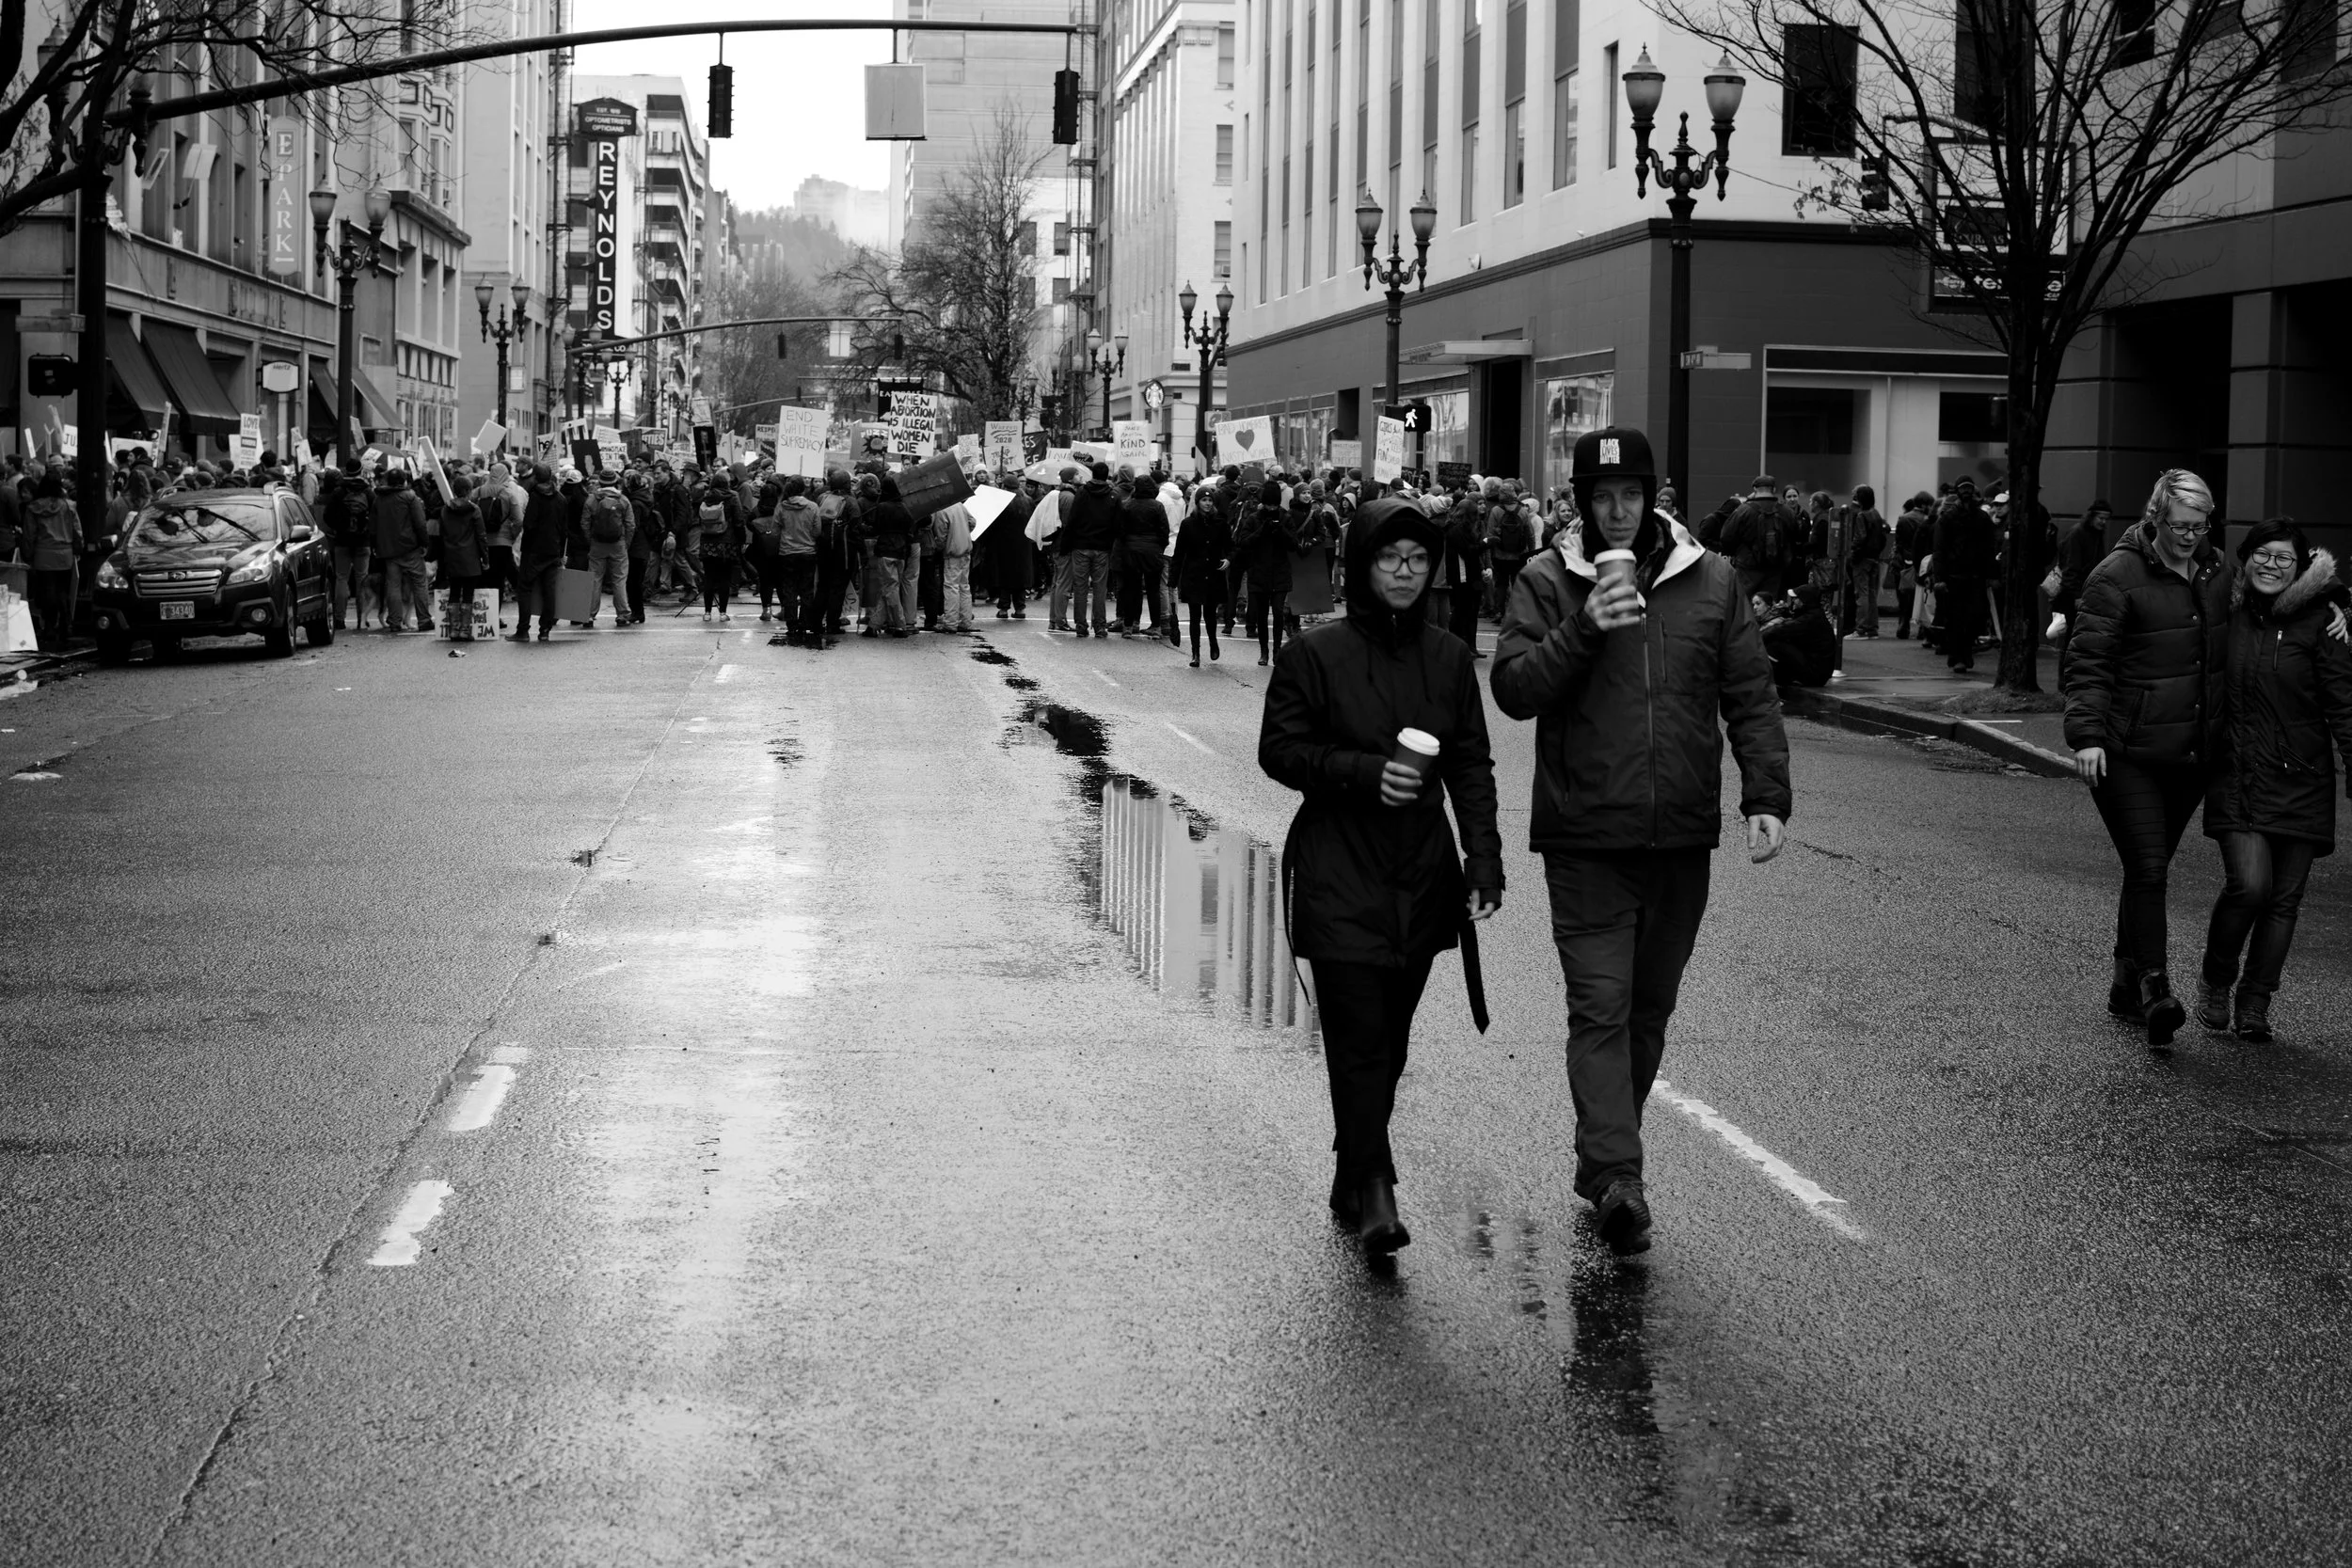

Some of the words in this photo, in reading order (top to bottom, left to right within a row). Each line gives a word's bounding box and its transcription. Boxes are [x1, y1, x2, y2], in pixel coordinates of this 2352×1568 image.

[584, 116, 632, 125] OPTOMETRISTS
[592, 124, 625, 133] OPTICIANS
[596, 141, 616, 330] REYNOLDS
[895, 394, 930, 406] WHEN
[787, 410, 813, 422] END
[890, 406, 936, 419] ABORTION
[244, 416, 259, 429] LOVE
[890, 417, 898, 427] IS
[902, 419, 934, 432] ILLEGAL
[784, 423, 821, 436] WHITE
[891, 429, 930, 443] WOMEN
[781, 435, 824, 453] SUPREMACY
[897, 441, 918, 453] DIE
[1599, 438, 1619, 447] BLACK
[1599, 447, 1619, 455] LIVES
[1599, 455, 1620, 465] MATTER
[477, 625, 495, 638] WE
